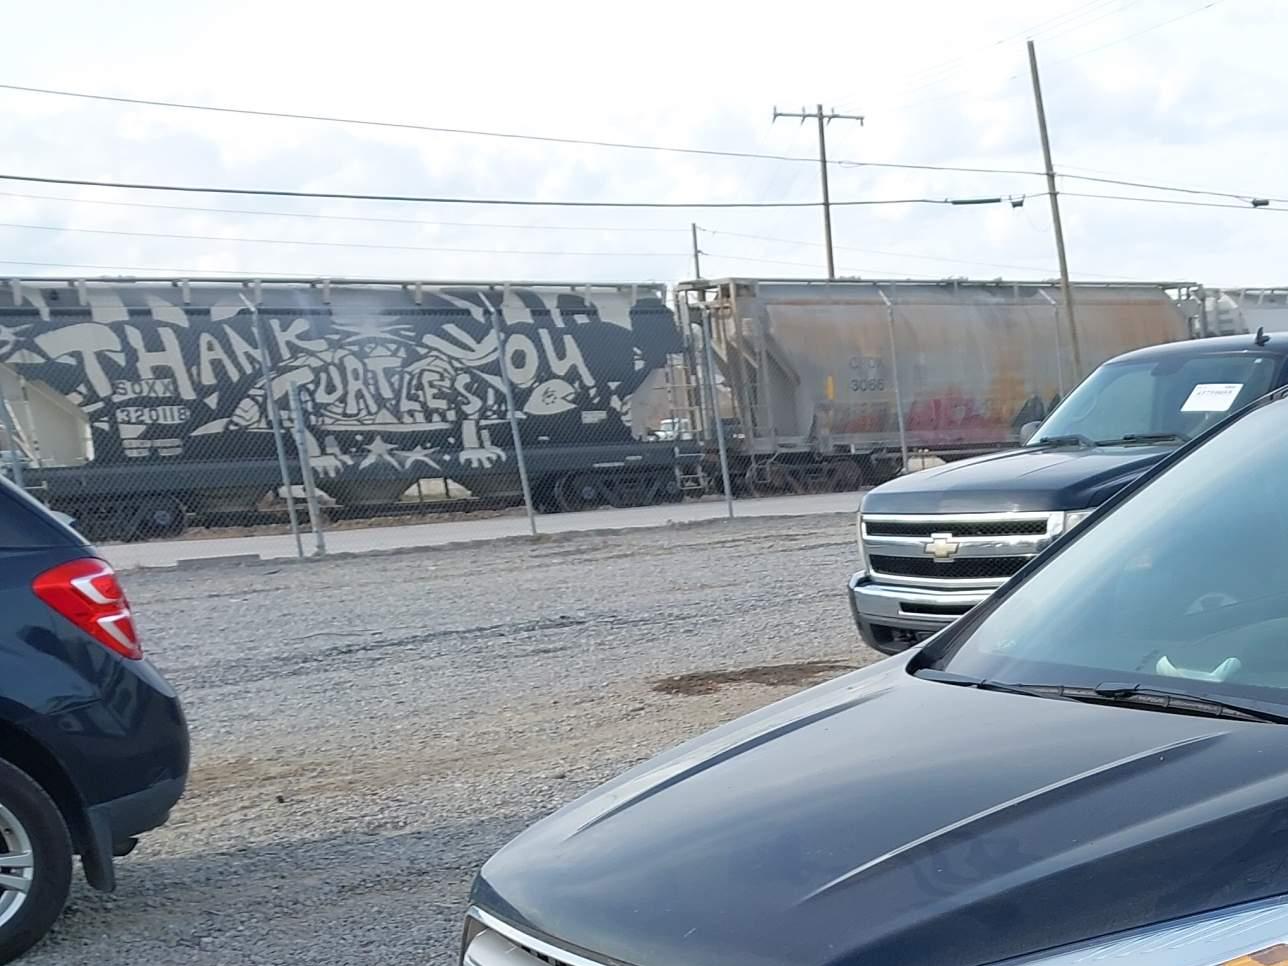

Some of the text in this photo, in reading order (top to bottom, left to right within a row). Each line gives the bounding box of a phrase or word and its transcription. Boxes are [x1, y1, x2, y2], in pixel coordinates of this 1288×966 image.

[34, 318, 328, 400] THANK
[114, 380, 175, 397] SOXX
[850, 378, 884, 391] 3066
